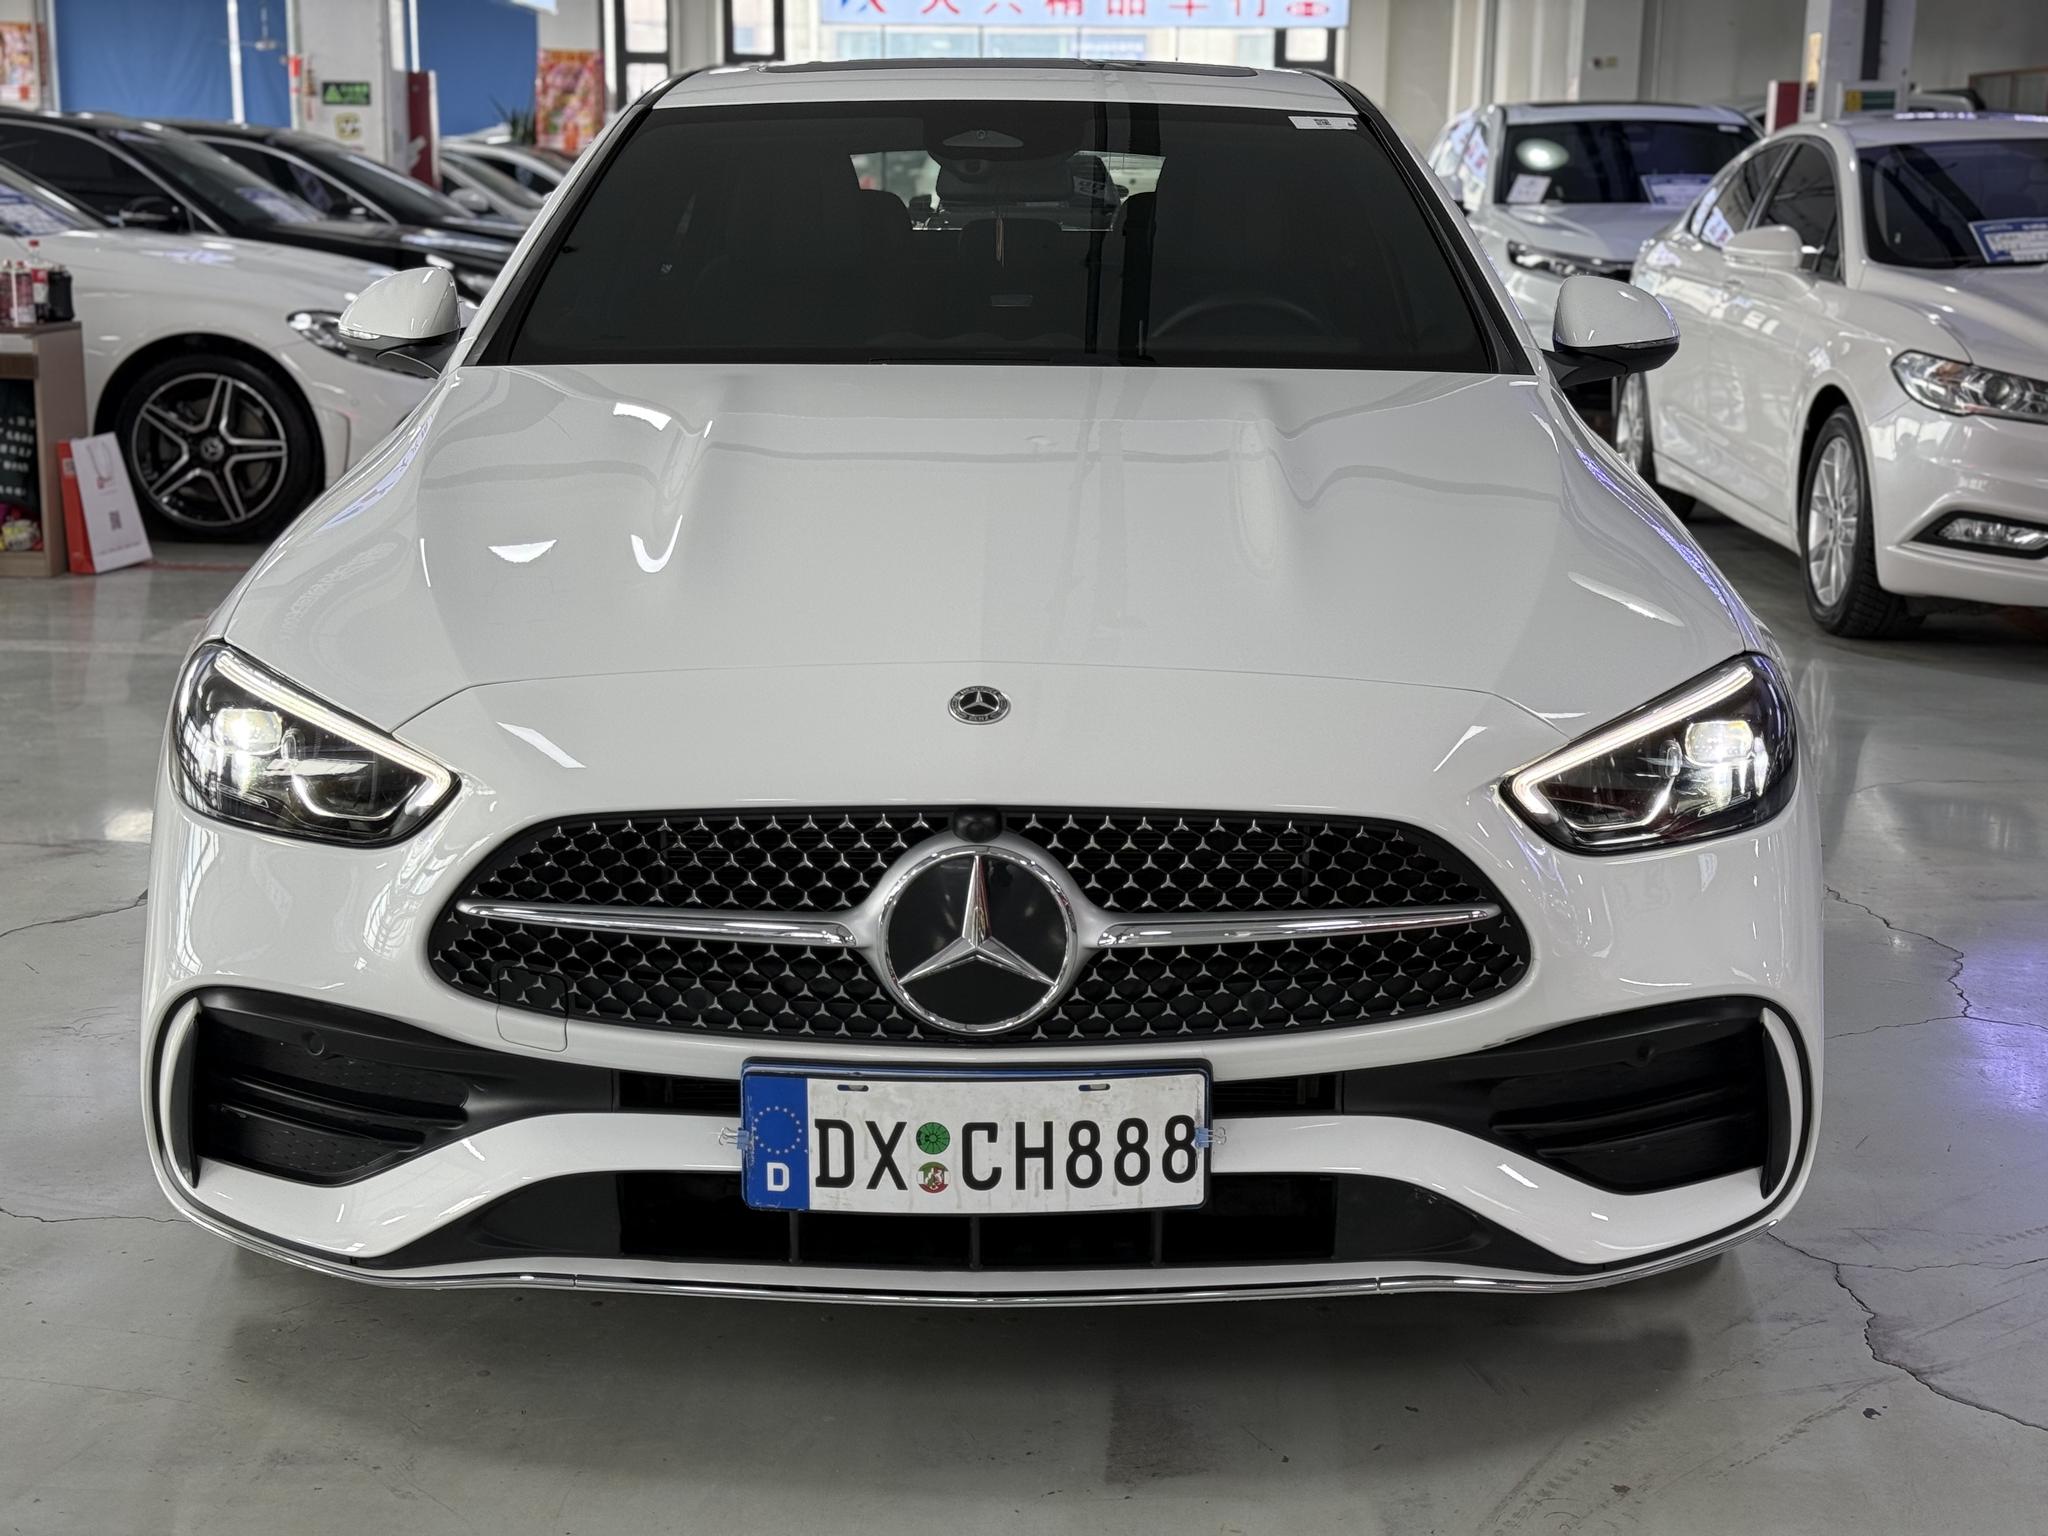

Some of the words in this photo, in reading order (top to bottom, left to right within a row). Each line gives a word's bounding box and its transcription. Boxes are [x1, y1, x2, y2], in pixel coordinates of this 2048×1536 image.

[766, 1162, 790, 1192] D
[814, 1118, 909, 1191] DX
[961, 1114, 1199, 1192] CH888
